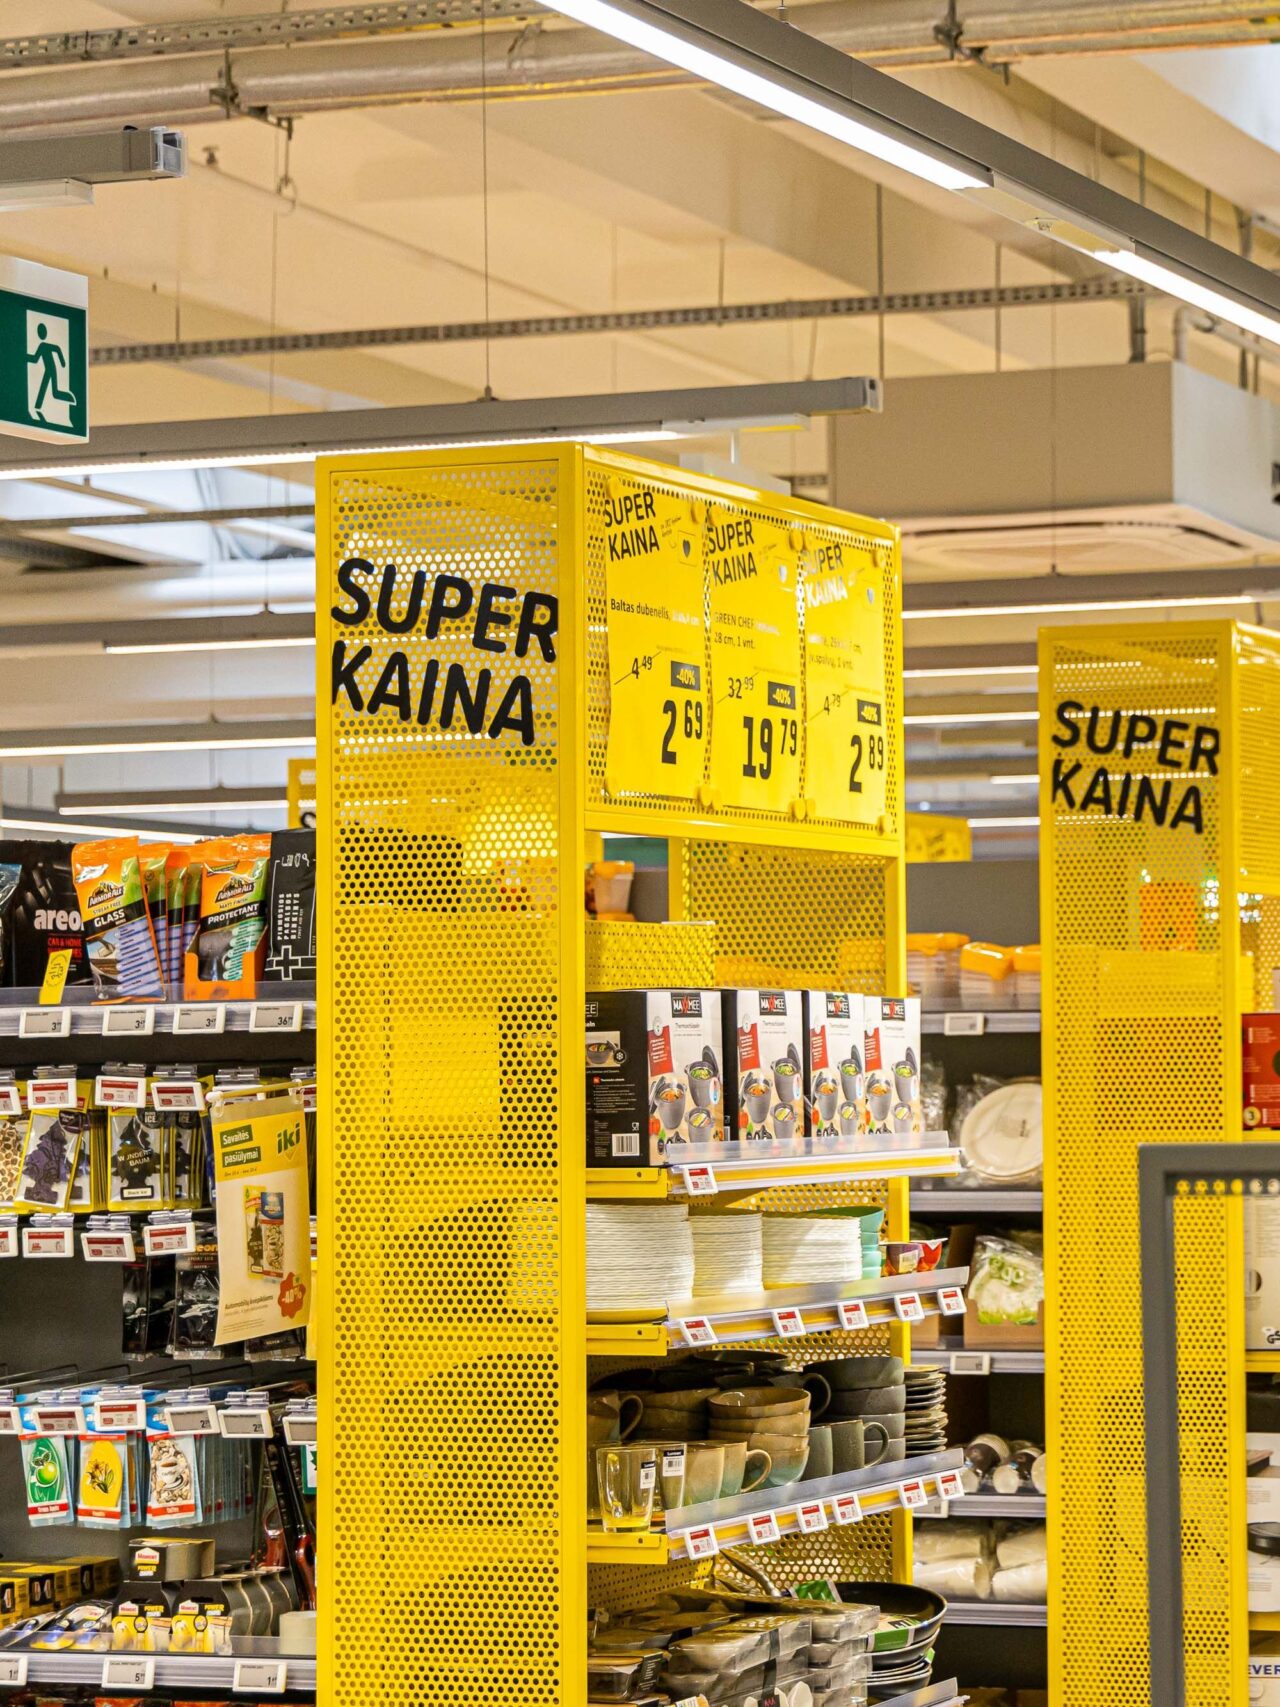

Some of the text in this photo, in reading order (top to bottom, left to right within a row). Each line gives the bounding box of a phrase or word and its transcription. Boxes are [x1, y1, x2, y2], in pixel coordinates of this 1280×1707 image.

[604, 491, 656, 527] SUPER
[608, 525, 660, 562] KAINA
[708, 519, 754, 554] SUPER
[712, 551, 757, 586] KAINA
[330, 557, 558, 664] SUPER
[610, 598, 634, 613] Baltas
[331, 640, 535, 746] KAINA
[676, 668, 695, 685] -40%
[743, 716, 797, 781] 19 79
[1051, 700, 1220, 776] SUPER
[1051, 756, 1204, 834] KAINA
[34, 908, 84, 931] areo
[94, 909, 125, 928] GLASS
[208, 903, 259, 925] PROTECTANT
[144, 1115, 156, 1123] ICE
[277, 1122, 300, 1154] iki
